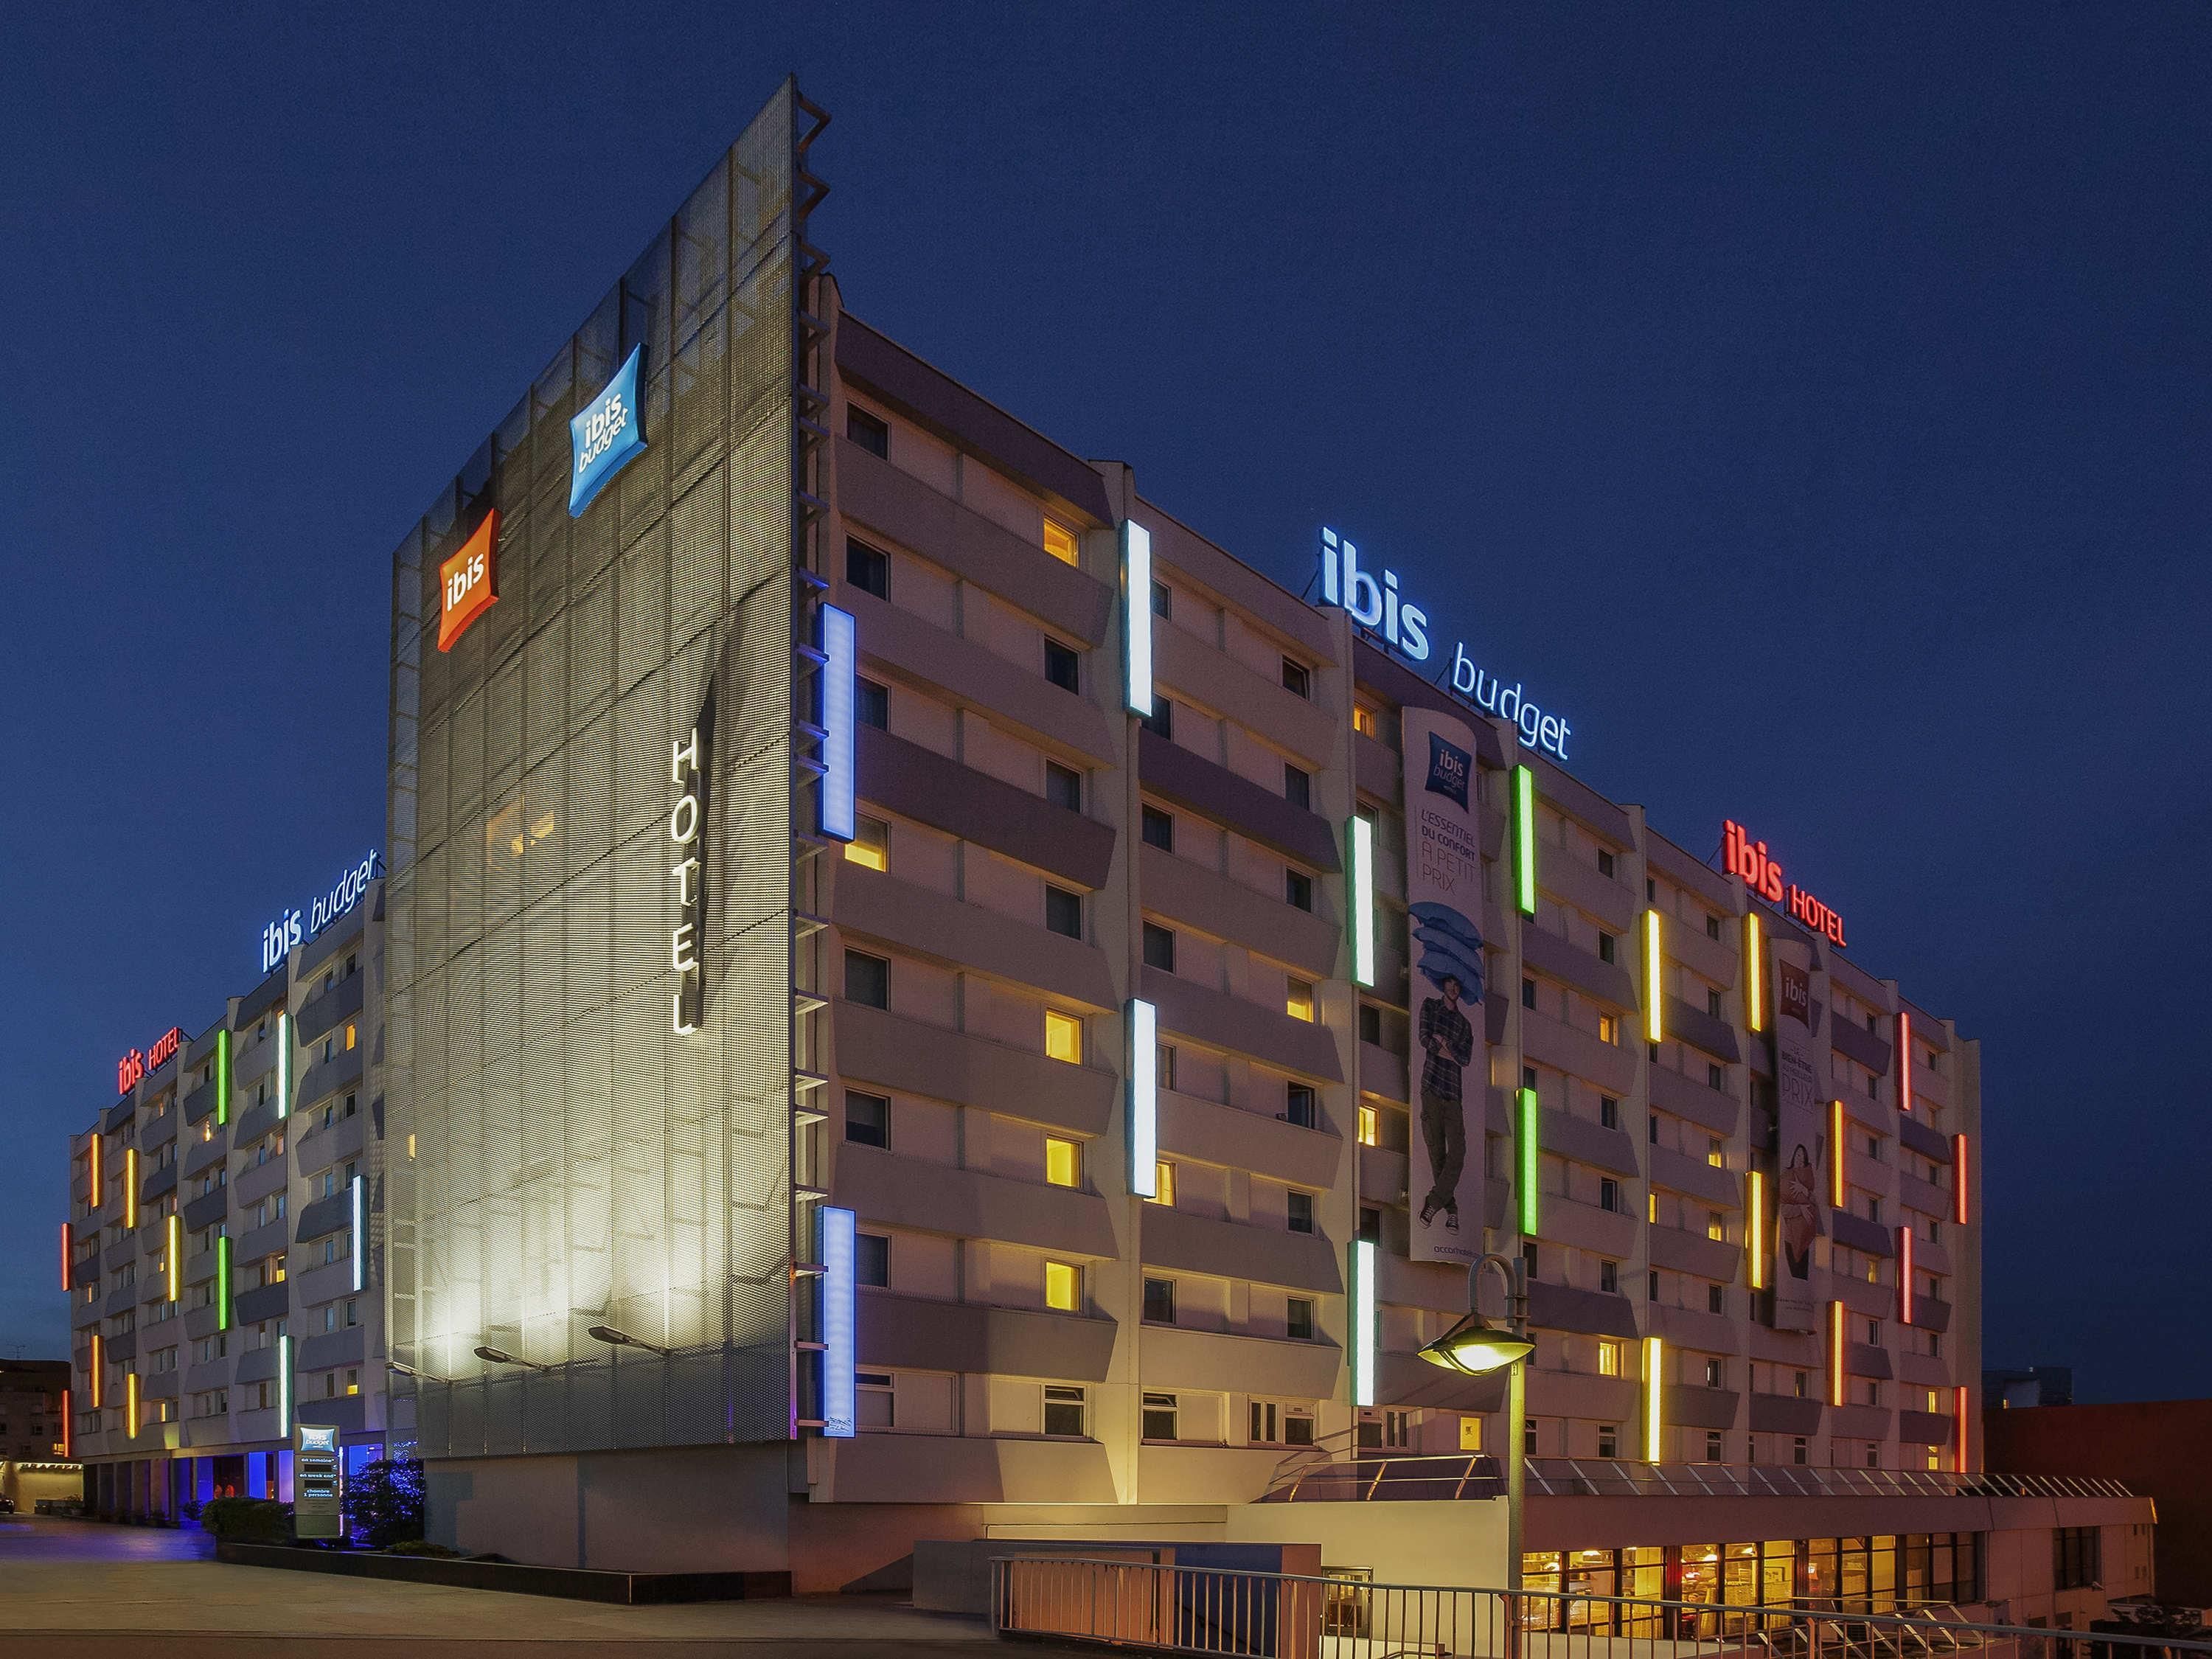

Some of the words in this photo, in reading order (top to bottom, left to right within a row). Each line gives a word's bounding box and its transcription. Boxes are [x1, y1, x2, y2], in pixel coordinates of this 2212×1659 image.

[579, 407, 629, 473] budget
[585, 392, 622, 448] ibis
[446, 552, 485, 611] ibis
[1322, 526, 1430, 661] ibis
[1453, 641, 1571, 760] budget
[1433, 764, 1465, 790] budget
[1439, 748, 1464, 776] ibis
[1422, 825, 1436, 841] DU
[671, 727, 700, 1034] HOTEL
[1422, 863, 1457, 897] PRIX
[1438, 847, 1475, 883] PETIT
[1723, 819, 1784, 902] ibis
[1790, 884, 1847, 947] HOTEL
[262, 908, 302, 973] ibis
[310, 849, 378, 934] budget
[1785, 977, 1807, 1006] ibis
[119, 1048, 144, 1095] ibis
[148, 1026, 179, 1071] HOTEL
